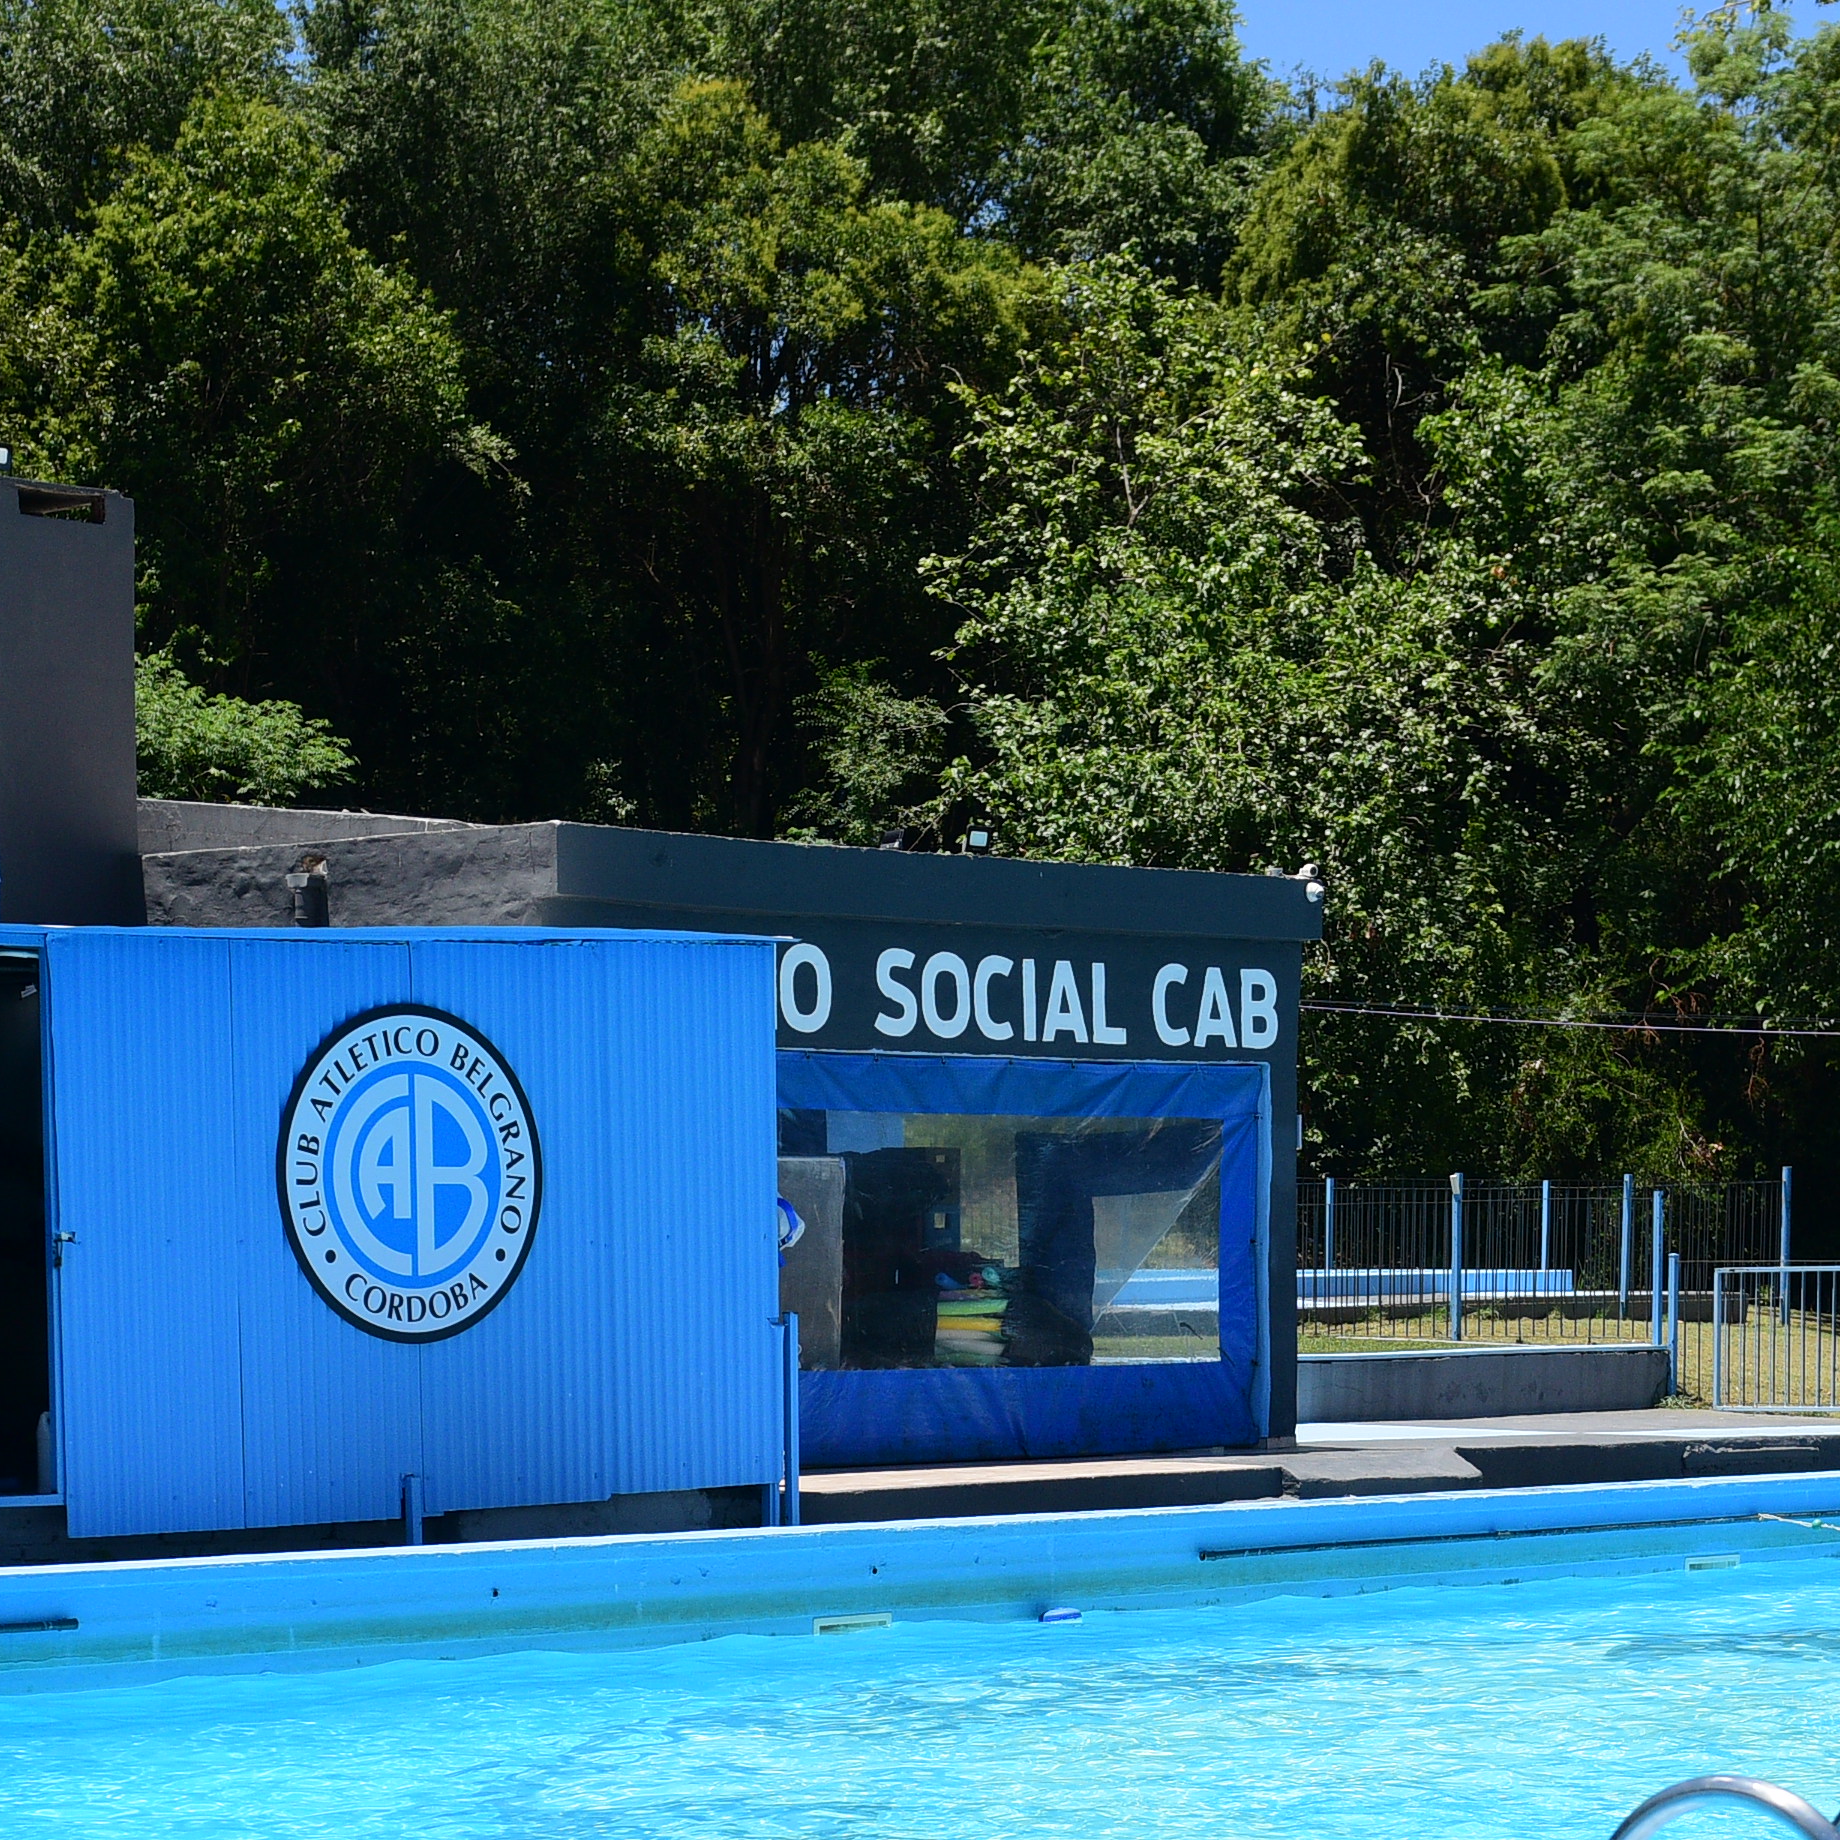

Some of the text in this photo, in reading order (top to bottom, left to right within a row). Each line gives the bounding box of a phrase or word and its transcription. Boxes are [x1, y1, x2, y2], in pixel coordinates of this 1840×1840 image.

[774, 943, 1279, 1050] O SOCIAL CAB
[295, 1026, 526, 1237] CLUB ATLETICO BELGRANO
[344, 1272, 489, 1323] CORDOBA
